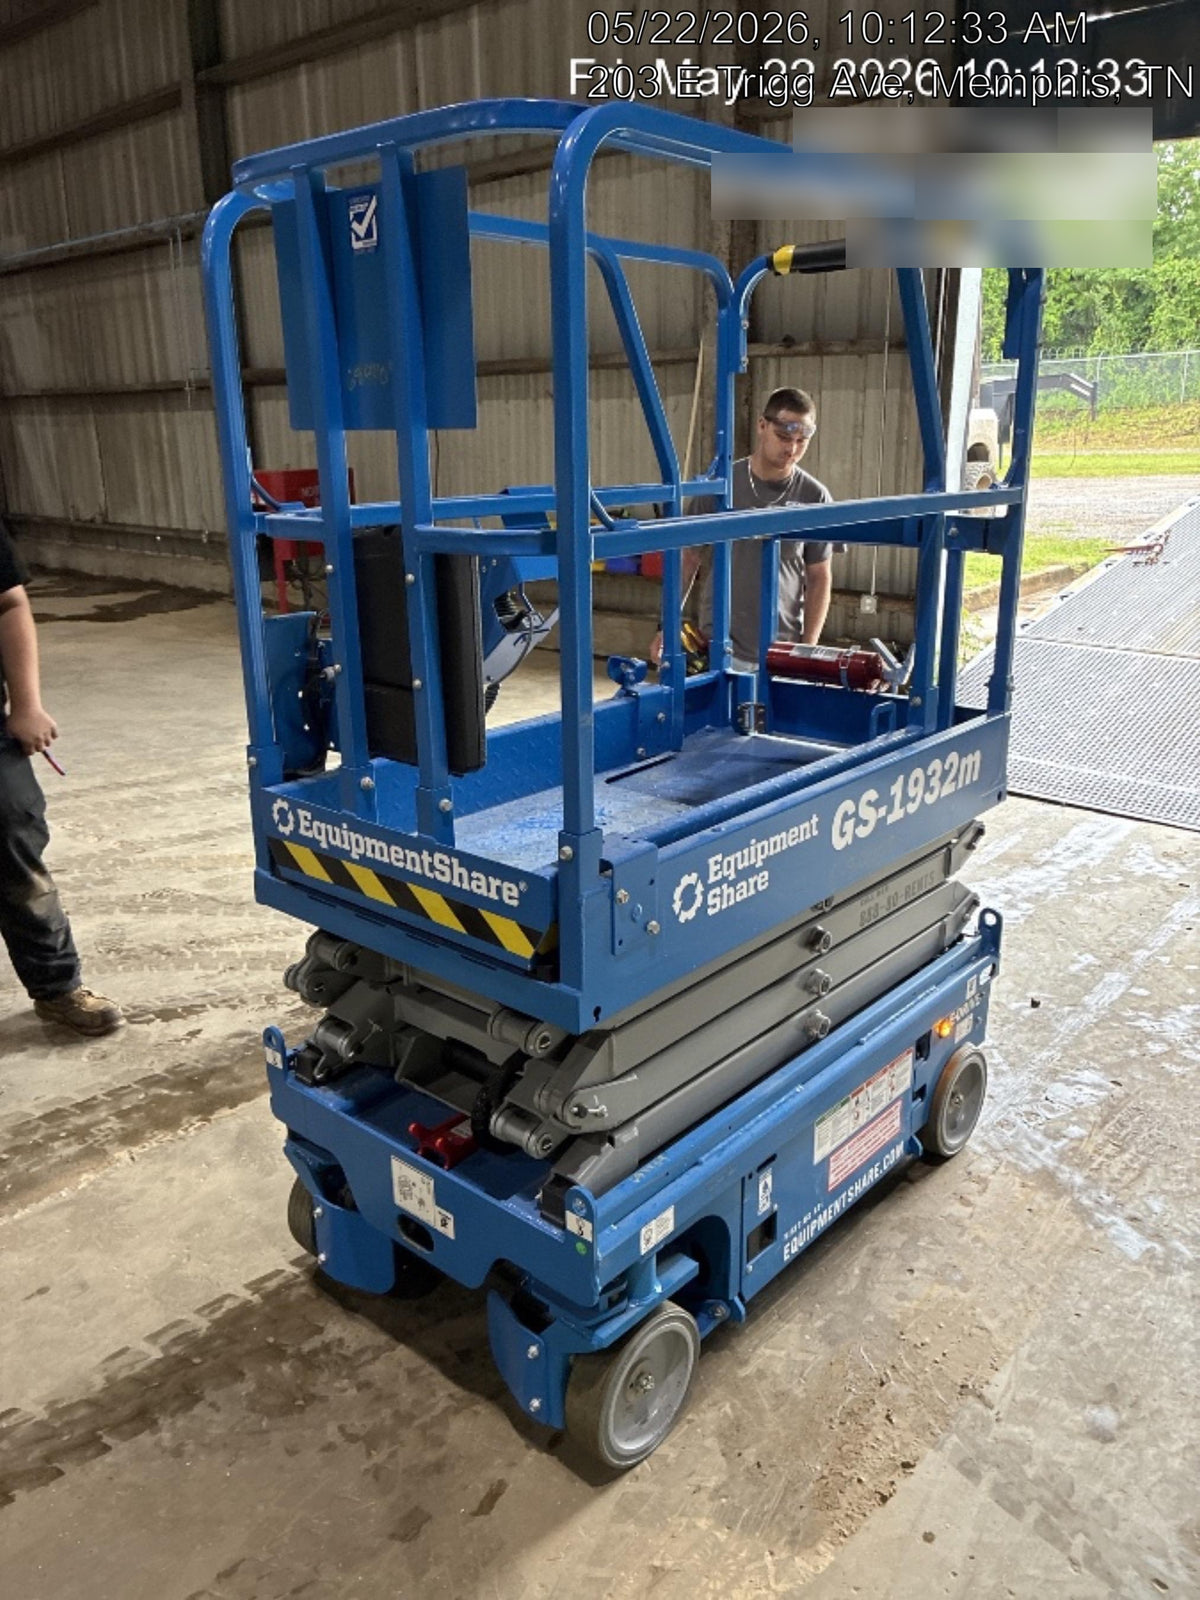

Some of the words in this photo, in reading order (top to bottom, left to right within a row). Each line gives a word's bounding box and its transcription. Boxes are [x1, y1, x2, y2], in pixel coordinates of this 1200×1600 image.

[831, 749, 981, 851] GS-1932m
[707, 813, 819, 884] Equipment
[706, 869, 769, 916] Share
[783, 1140, 905, 1262] EQUIPMENTSHARE.COM
